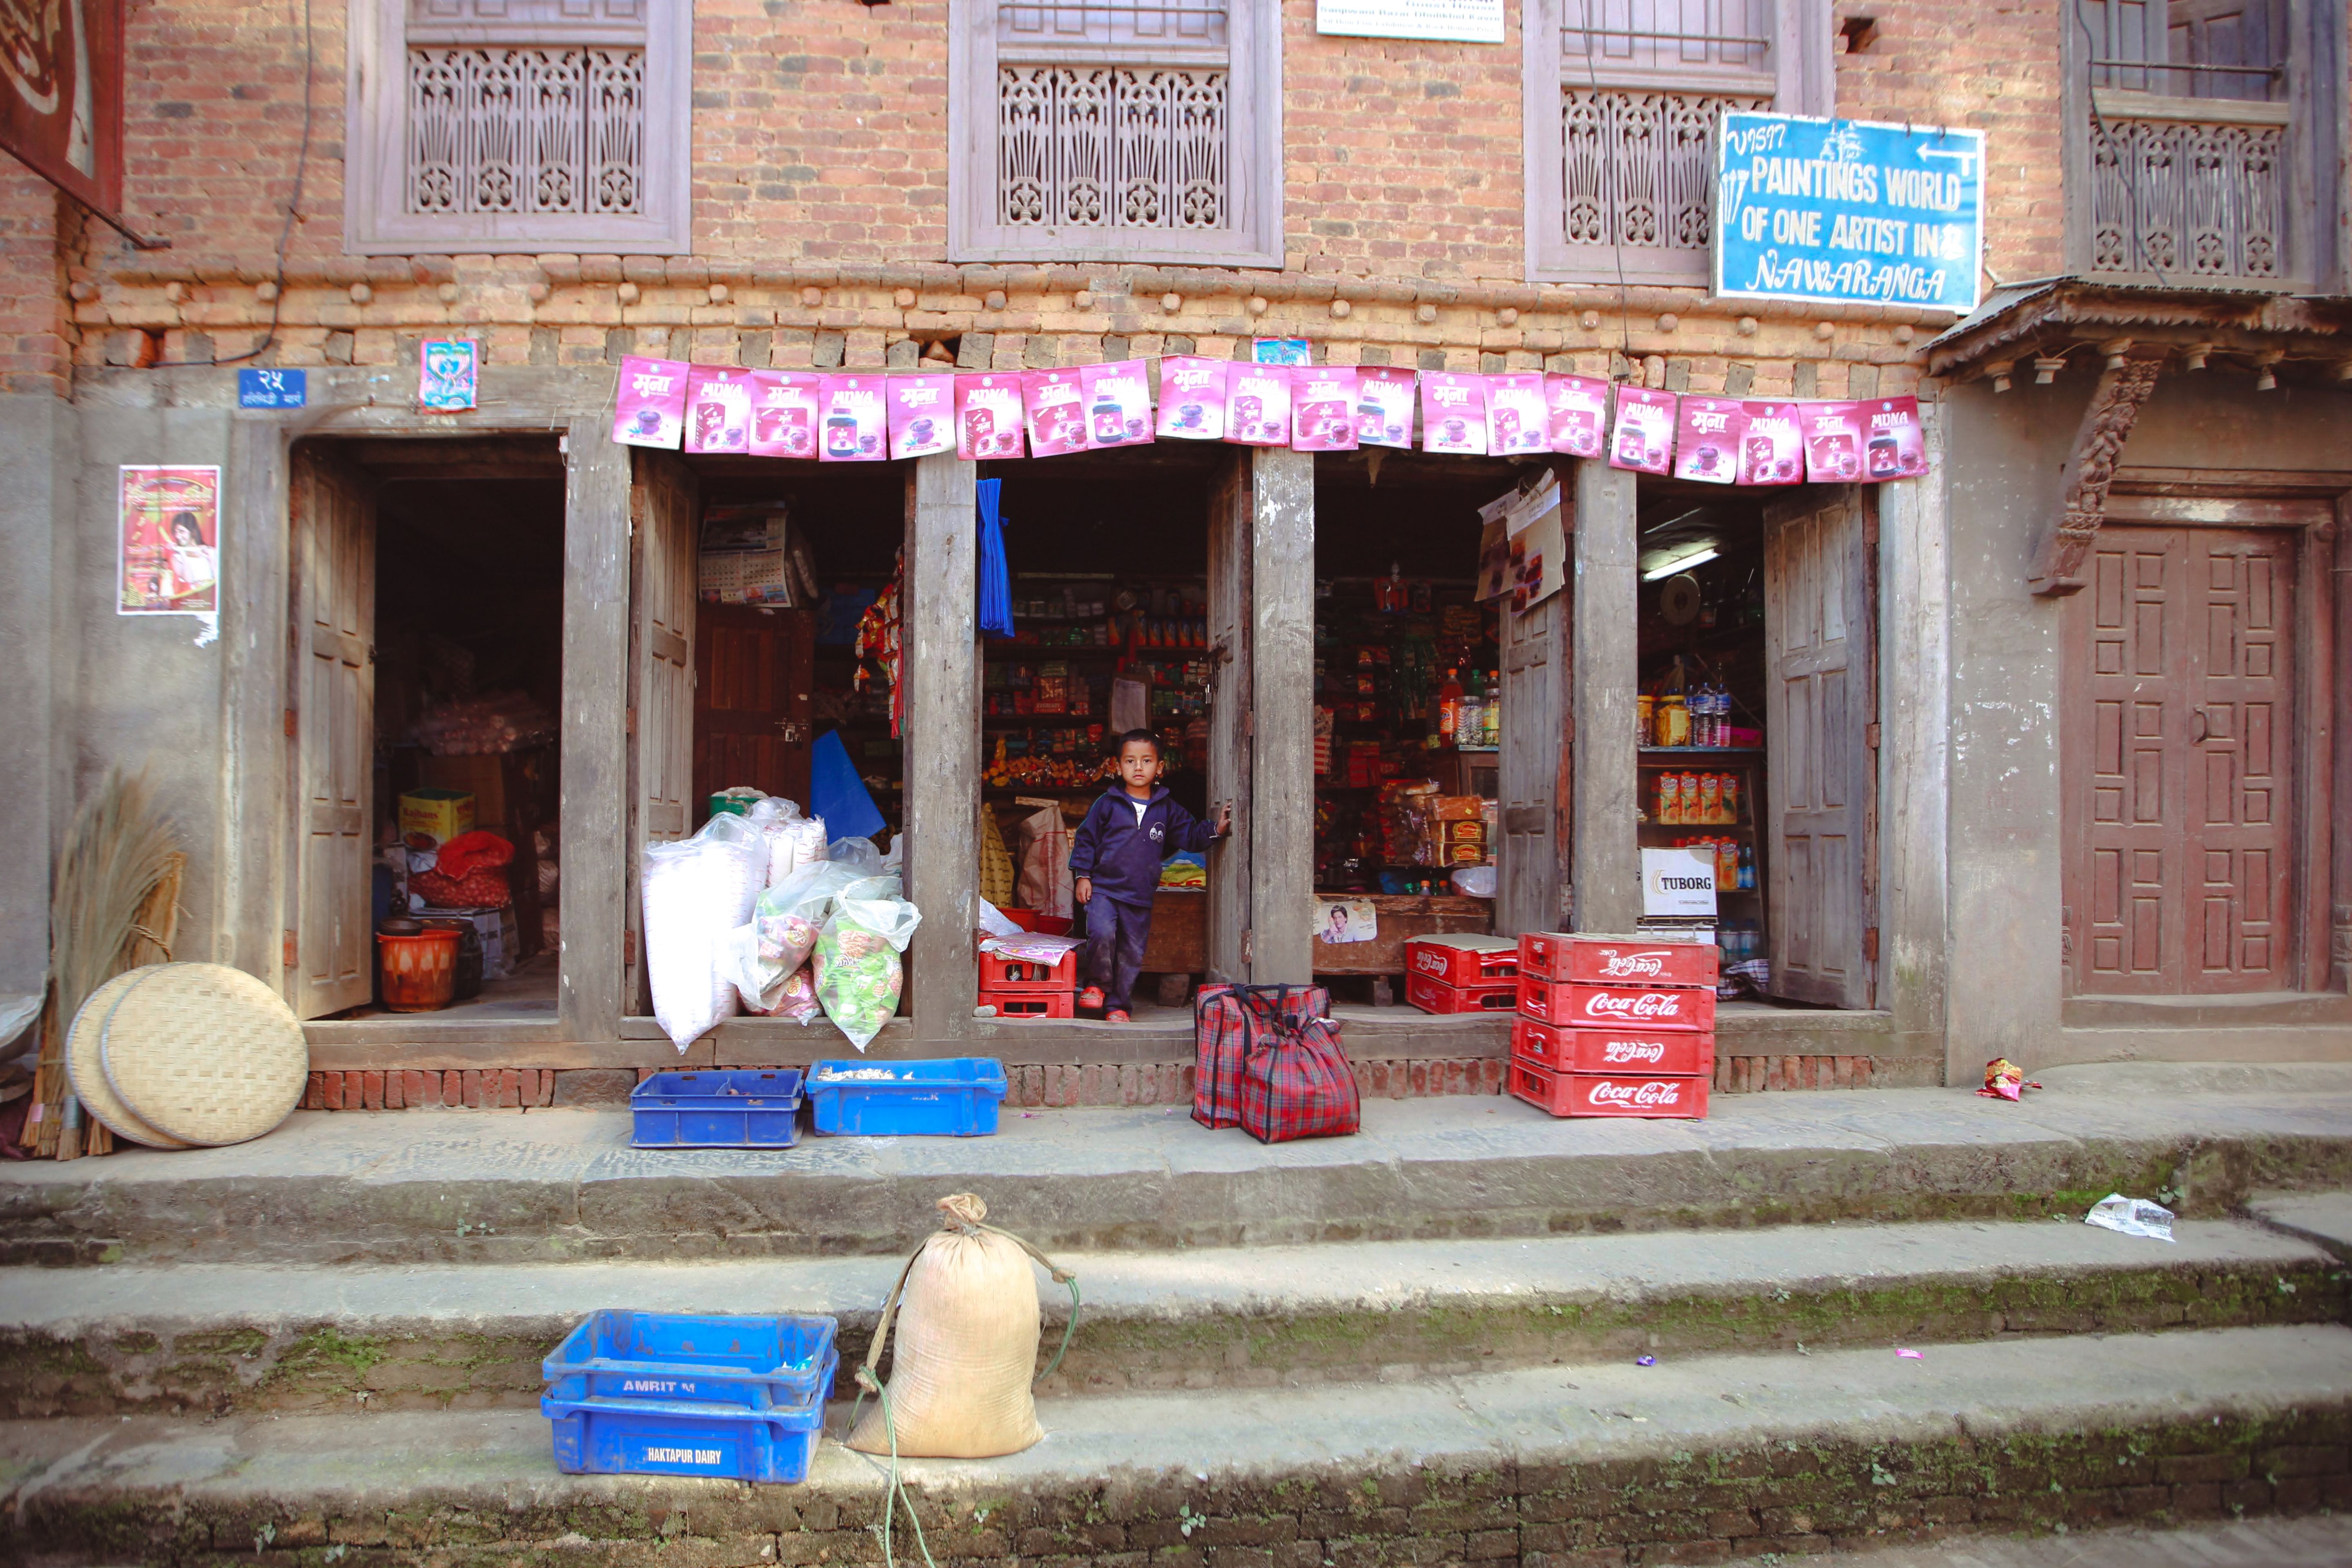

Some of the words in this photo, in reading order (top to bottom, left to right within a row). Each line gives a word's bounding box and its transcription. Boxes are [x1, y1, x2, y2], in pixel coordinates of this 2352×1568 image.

[1752, 156, 1878, 203] PAINTINGS
[1884, 166, 1962, 212] WORLD
[1742, 205, 1768, 242] OF
[1773, 208, 1822, 247] ONE
[1829, 214, 1907, 256] ARTIST
[1913, 223, 1939, 258] IN
[1745, 249, 1946, 301] NAWARANGA
[1661, 877, 1712, 890] TUBORG
[623, 1381, 676, 1392] AMRIT
[643, 1446, 693, 1463] HAKTAPUR
[695, 1450, 721, 1464] DAIRY
